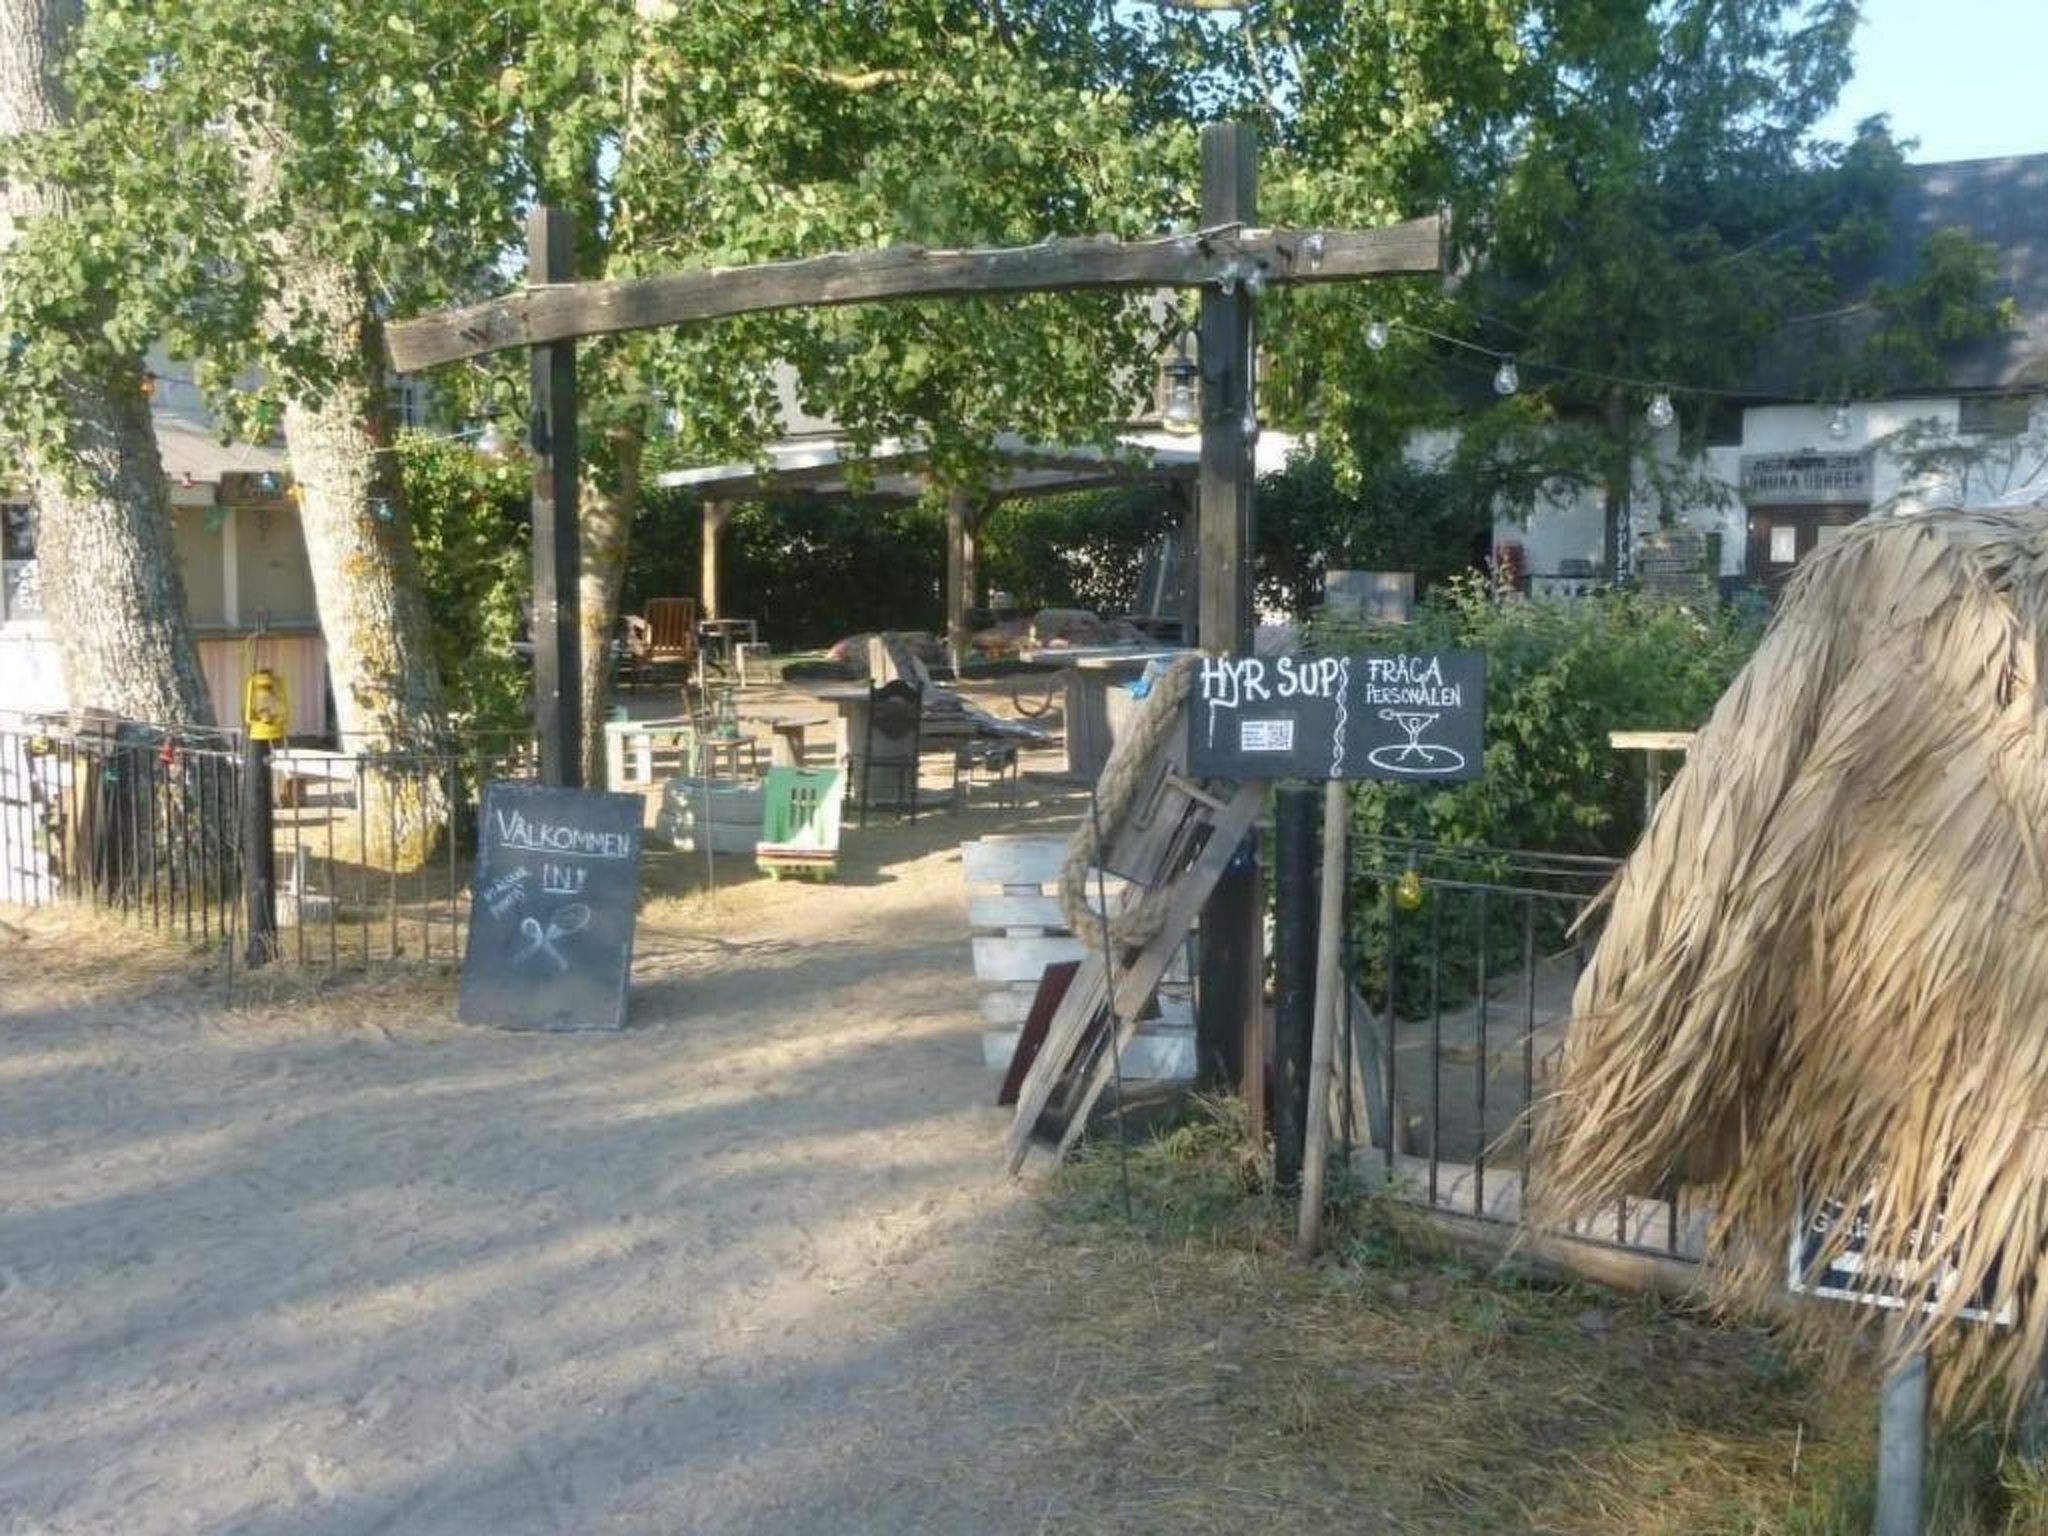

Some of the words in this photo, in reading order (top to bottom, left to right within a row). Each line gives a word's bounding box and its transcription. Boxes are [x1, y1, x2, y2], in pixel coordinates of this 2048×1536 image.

[1200, 656, 1271, 707] HYR
[1367, 653, 1444, 686] FRÅGA
[1366, 682, 1462, 708] PERSONALEN
